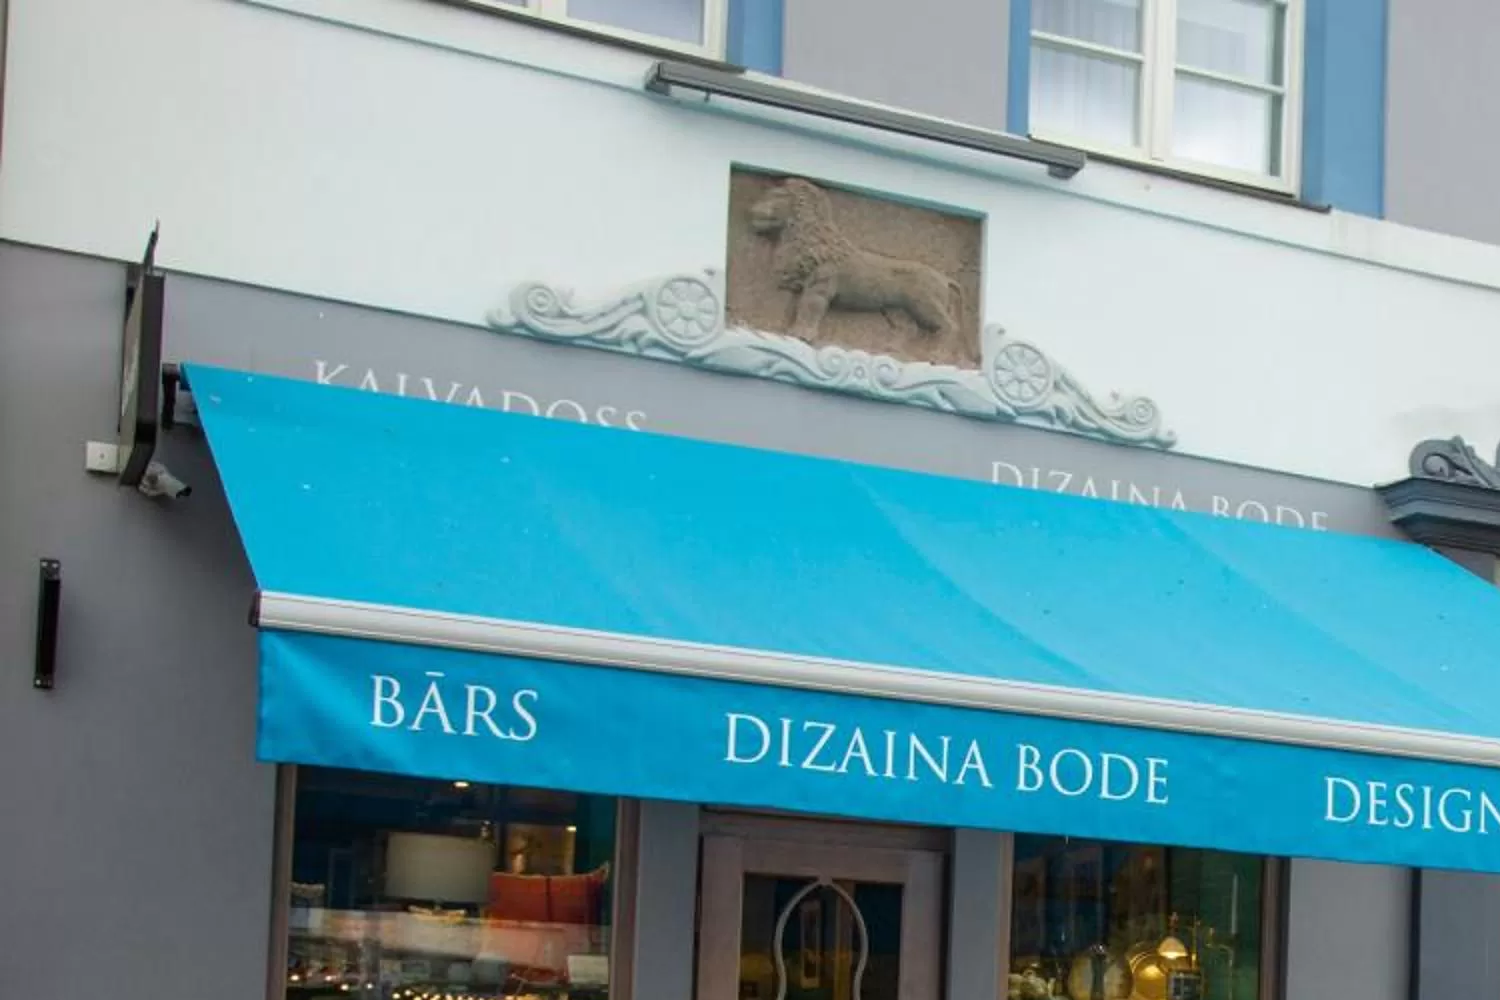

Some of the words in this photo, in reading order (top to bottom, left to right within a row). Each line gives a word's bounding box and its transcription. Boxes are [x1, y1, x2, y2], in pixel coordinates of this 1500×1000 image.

[369, 671, 539, 741] BĀRS
[724, 712, 993, 788] DIZAINA
[1016, 743, 1168, 805] BODE
